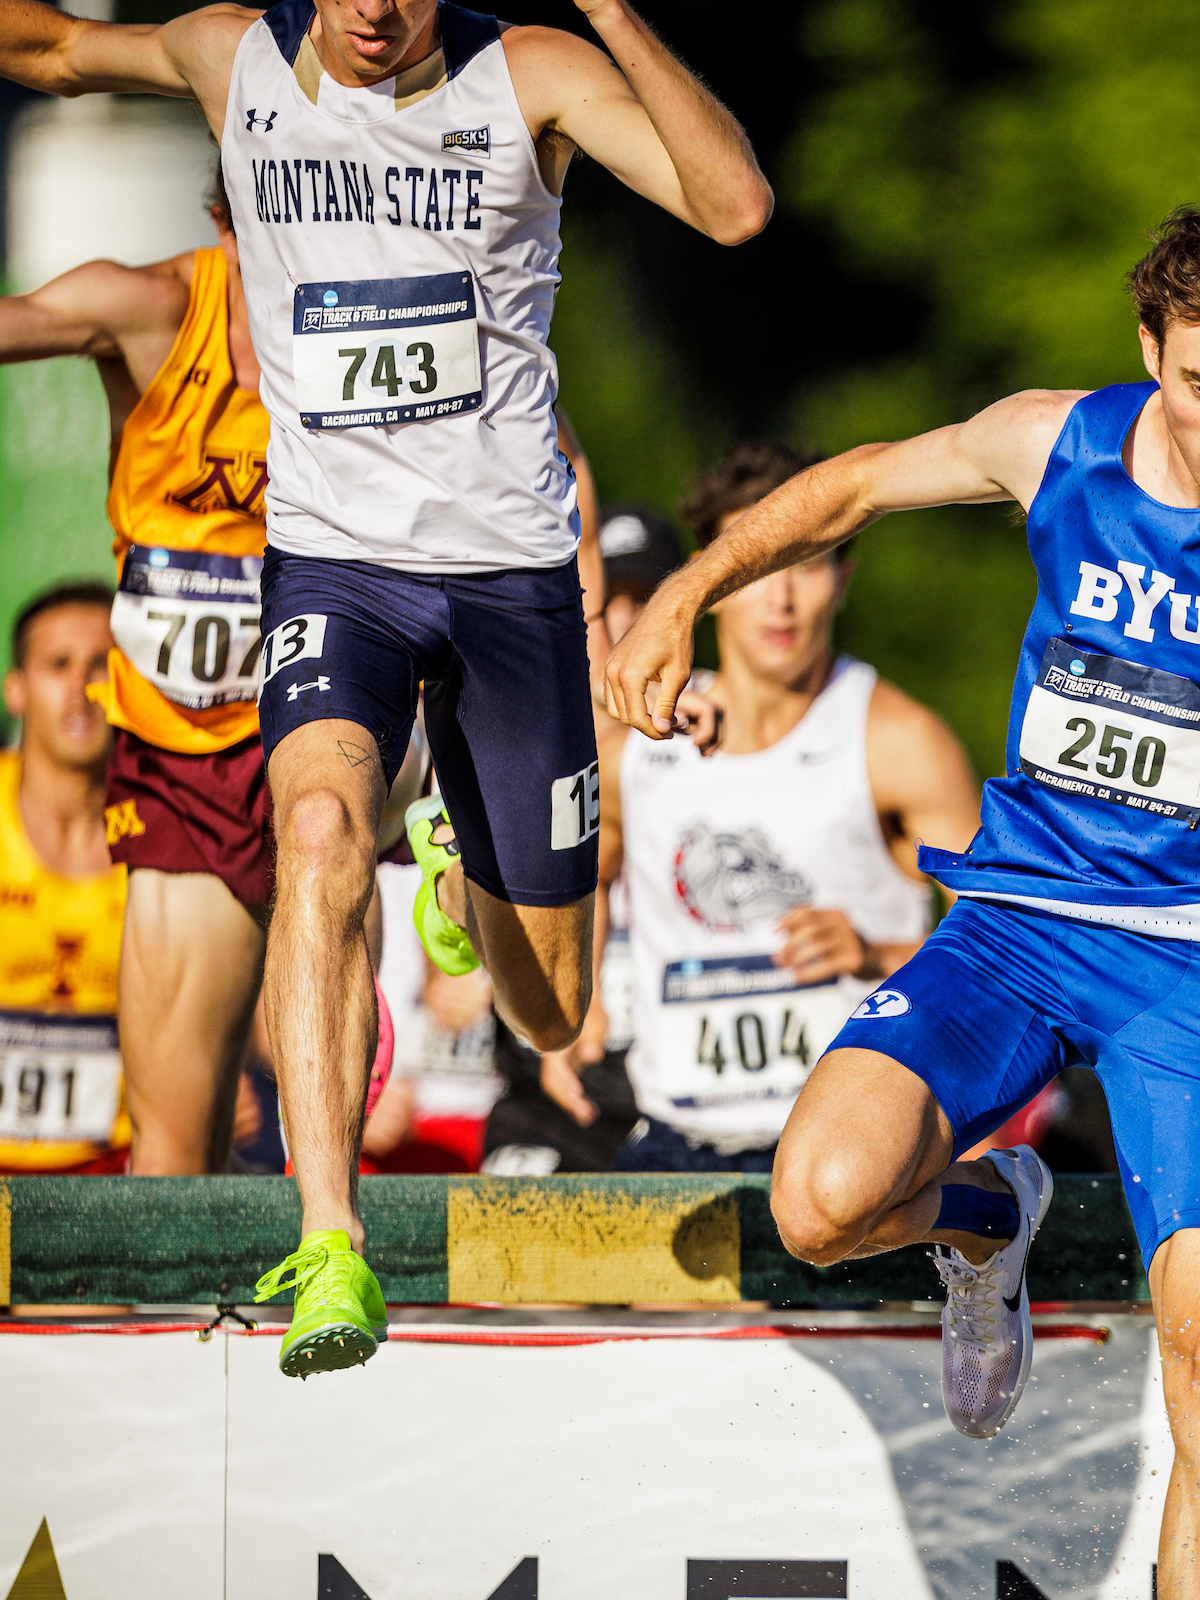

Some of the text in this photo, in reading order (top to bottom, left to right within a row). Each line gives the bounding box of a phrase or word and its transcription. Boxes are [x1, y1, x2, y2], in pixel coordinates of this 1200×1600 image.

[252, 159, 484, 232] MONTANA STATE
[322, 300, 468, 324] TRACK & FIELD CHAMPIONSHIPS
[338, 341, 438, 401] 743
[321, 399, 464, 427] SACRAMENTO, CA MAY 24-27
[147, 610, 262, 683] 707
[262, 616, 309, 682] 13
[1064, 678, 1095, 694] TRACK
[1095, 686, 1103, 696] &
[1103, 687, 1130, 704] FIELD
[1057, 717, 1166, 788] 250
[1034, 769, 1178, 817] SACRAMENTO, CA MAY 24-27
[106, 800, 146, 845] M
[862, 993, 900, 1016] Y
[697, 1009, 810, 1075] 404
[0, 1066, 76, 1119] 91
